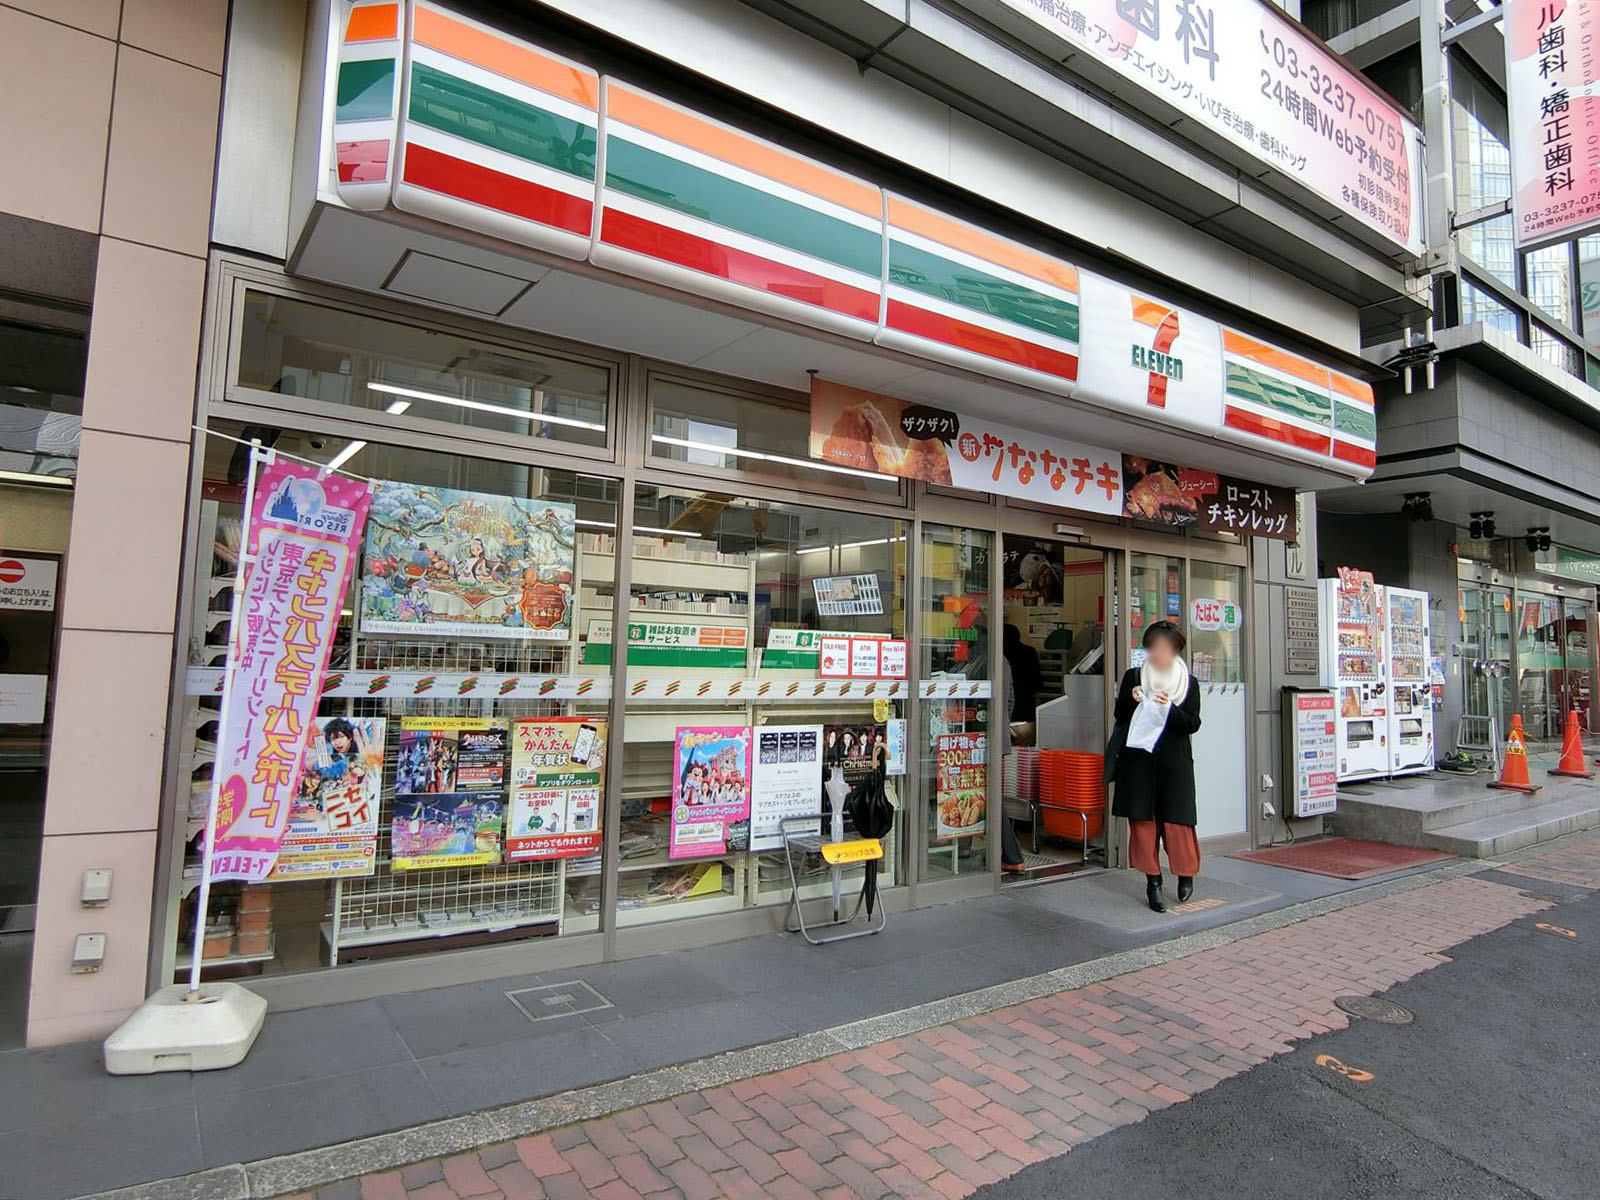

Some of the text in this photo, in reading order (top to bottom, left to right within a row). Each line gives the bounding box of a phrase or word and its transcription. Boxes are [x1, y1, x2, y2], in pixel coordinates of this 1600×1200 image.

[1273, 37, 1406, 157] 03-3237-0757
[1581, 34, 1593, 127] Orthodontic
[1587, 135, 1599, 185] Office
[1260, 69, 1409, 194] 24時間Web予約受付
[961, 437, 976, 456] 新
[1226, 485, 1273, 511] ロースト
[1208, 503, 1288, 534] チキンレッグ
[1194, 603, 1221, 623] たばこ
[1224, 604, 1236, 624] 酒
[647, 636, 681, 645] サービス
[648, 624, 698, 637] 雑誌お取置き
[520, 726, 563, 738] スマホで
[524, 739, 573, 752] かんたん
[532, 752, 570, 767] 年賀状
